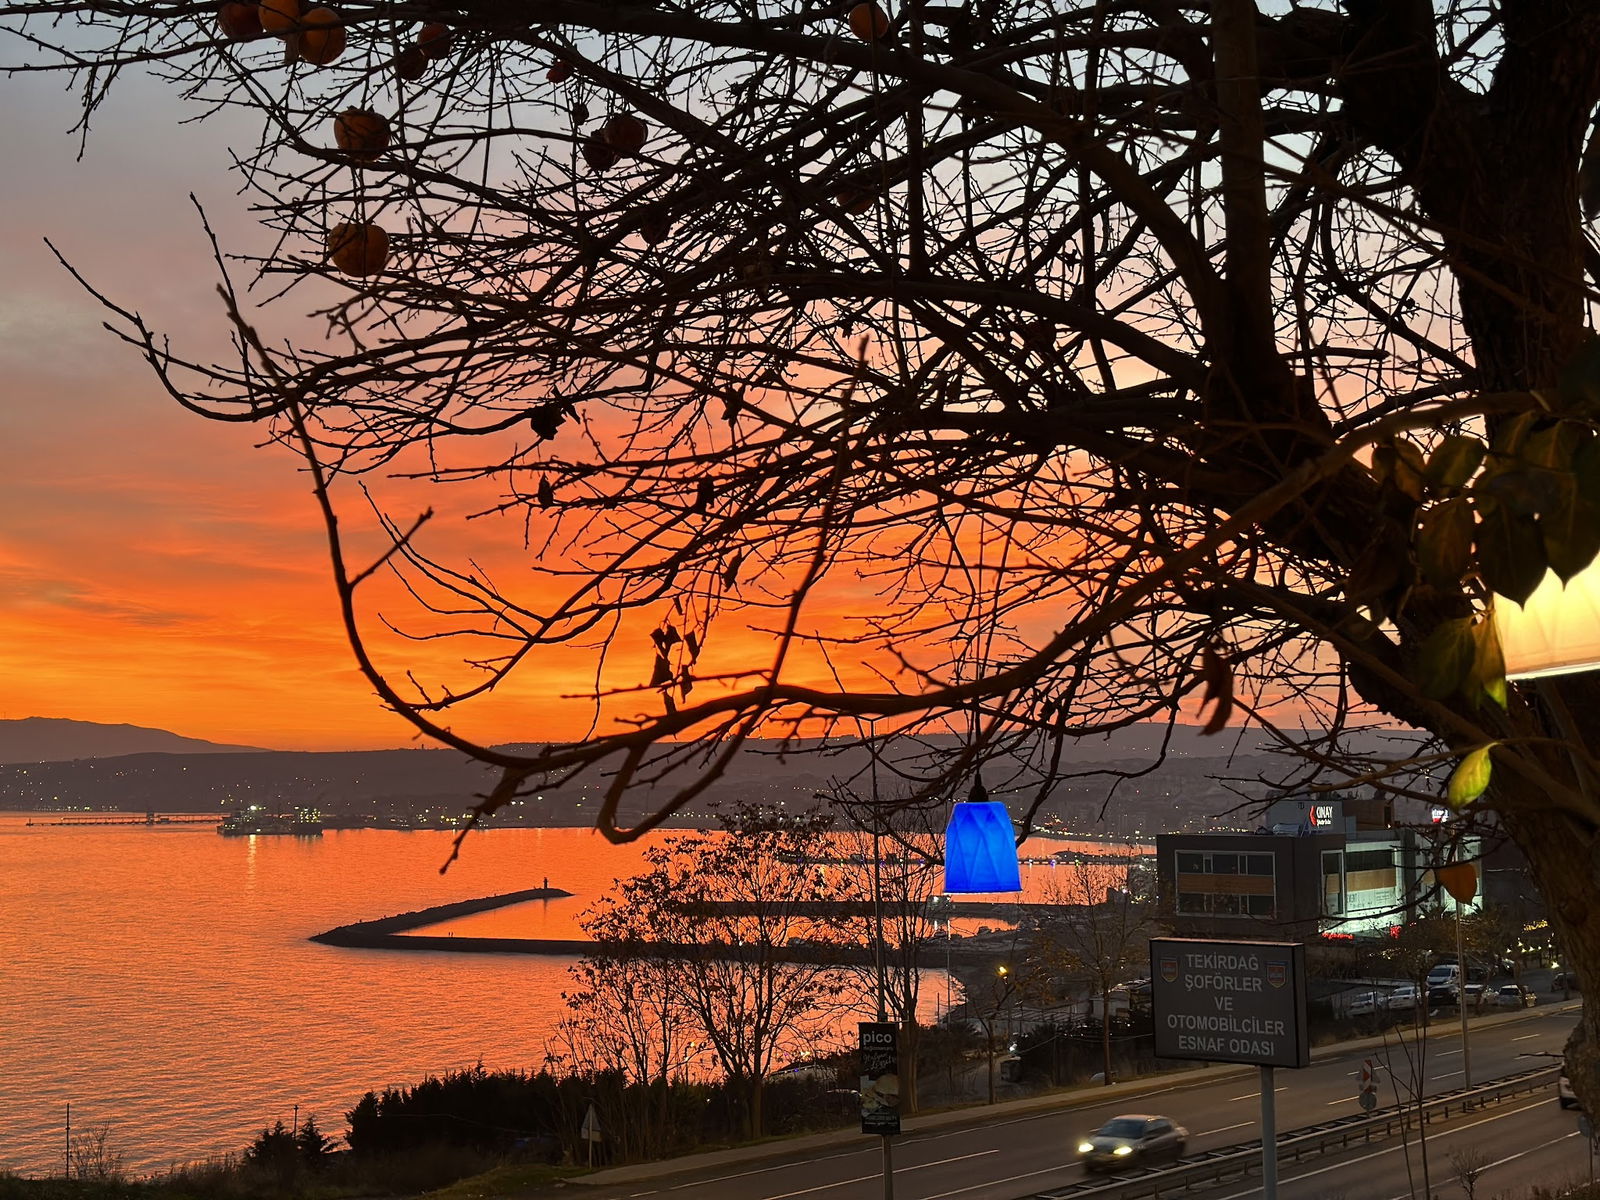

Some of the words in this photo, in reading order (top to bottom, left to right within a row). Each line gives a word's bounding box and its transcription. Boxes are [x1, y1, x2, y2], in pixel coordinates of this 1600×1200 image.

[1186, 952, 1258, 970] TEKİRDAĞ
[1185, 972, 1262, 992] ŞOFÖRLER
[1215, 996, 1233, 1011] VE
[1167, 1014, 1284, 1036] OTOMOBİLCİLER
[863, 1031, 892, 1045] pico
[1178, 1035, 1225, 1052] ESNAF
[1229, 1038, 1274, 1056] ODASI
